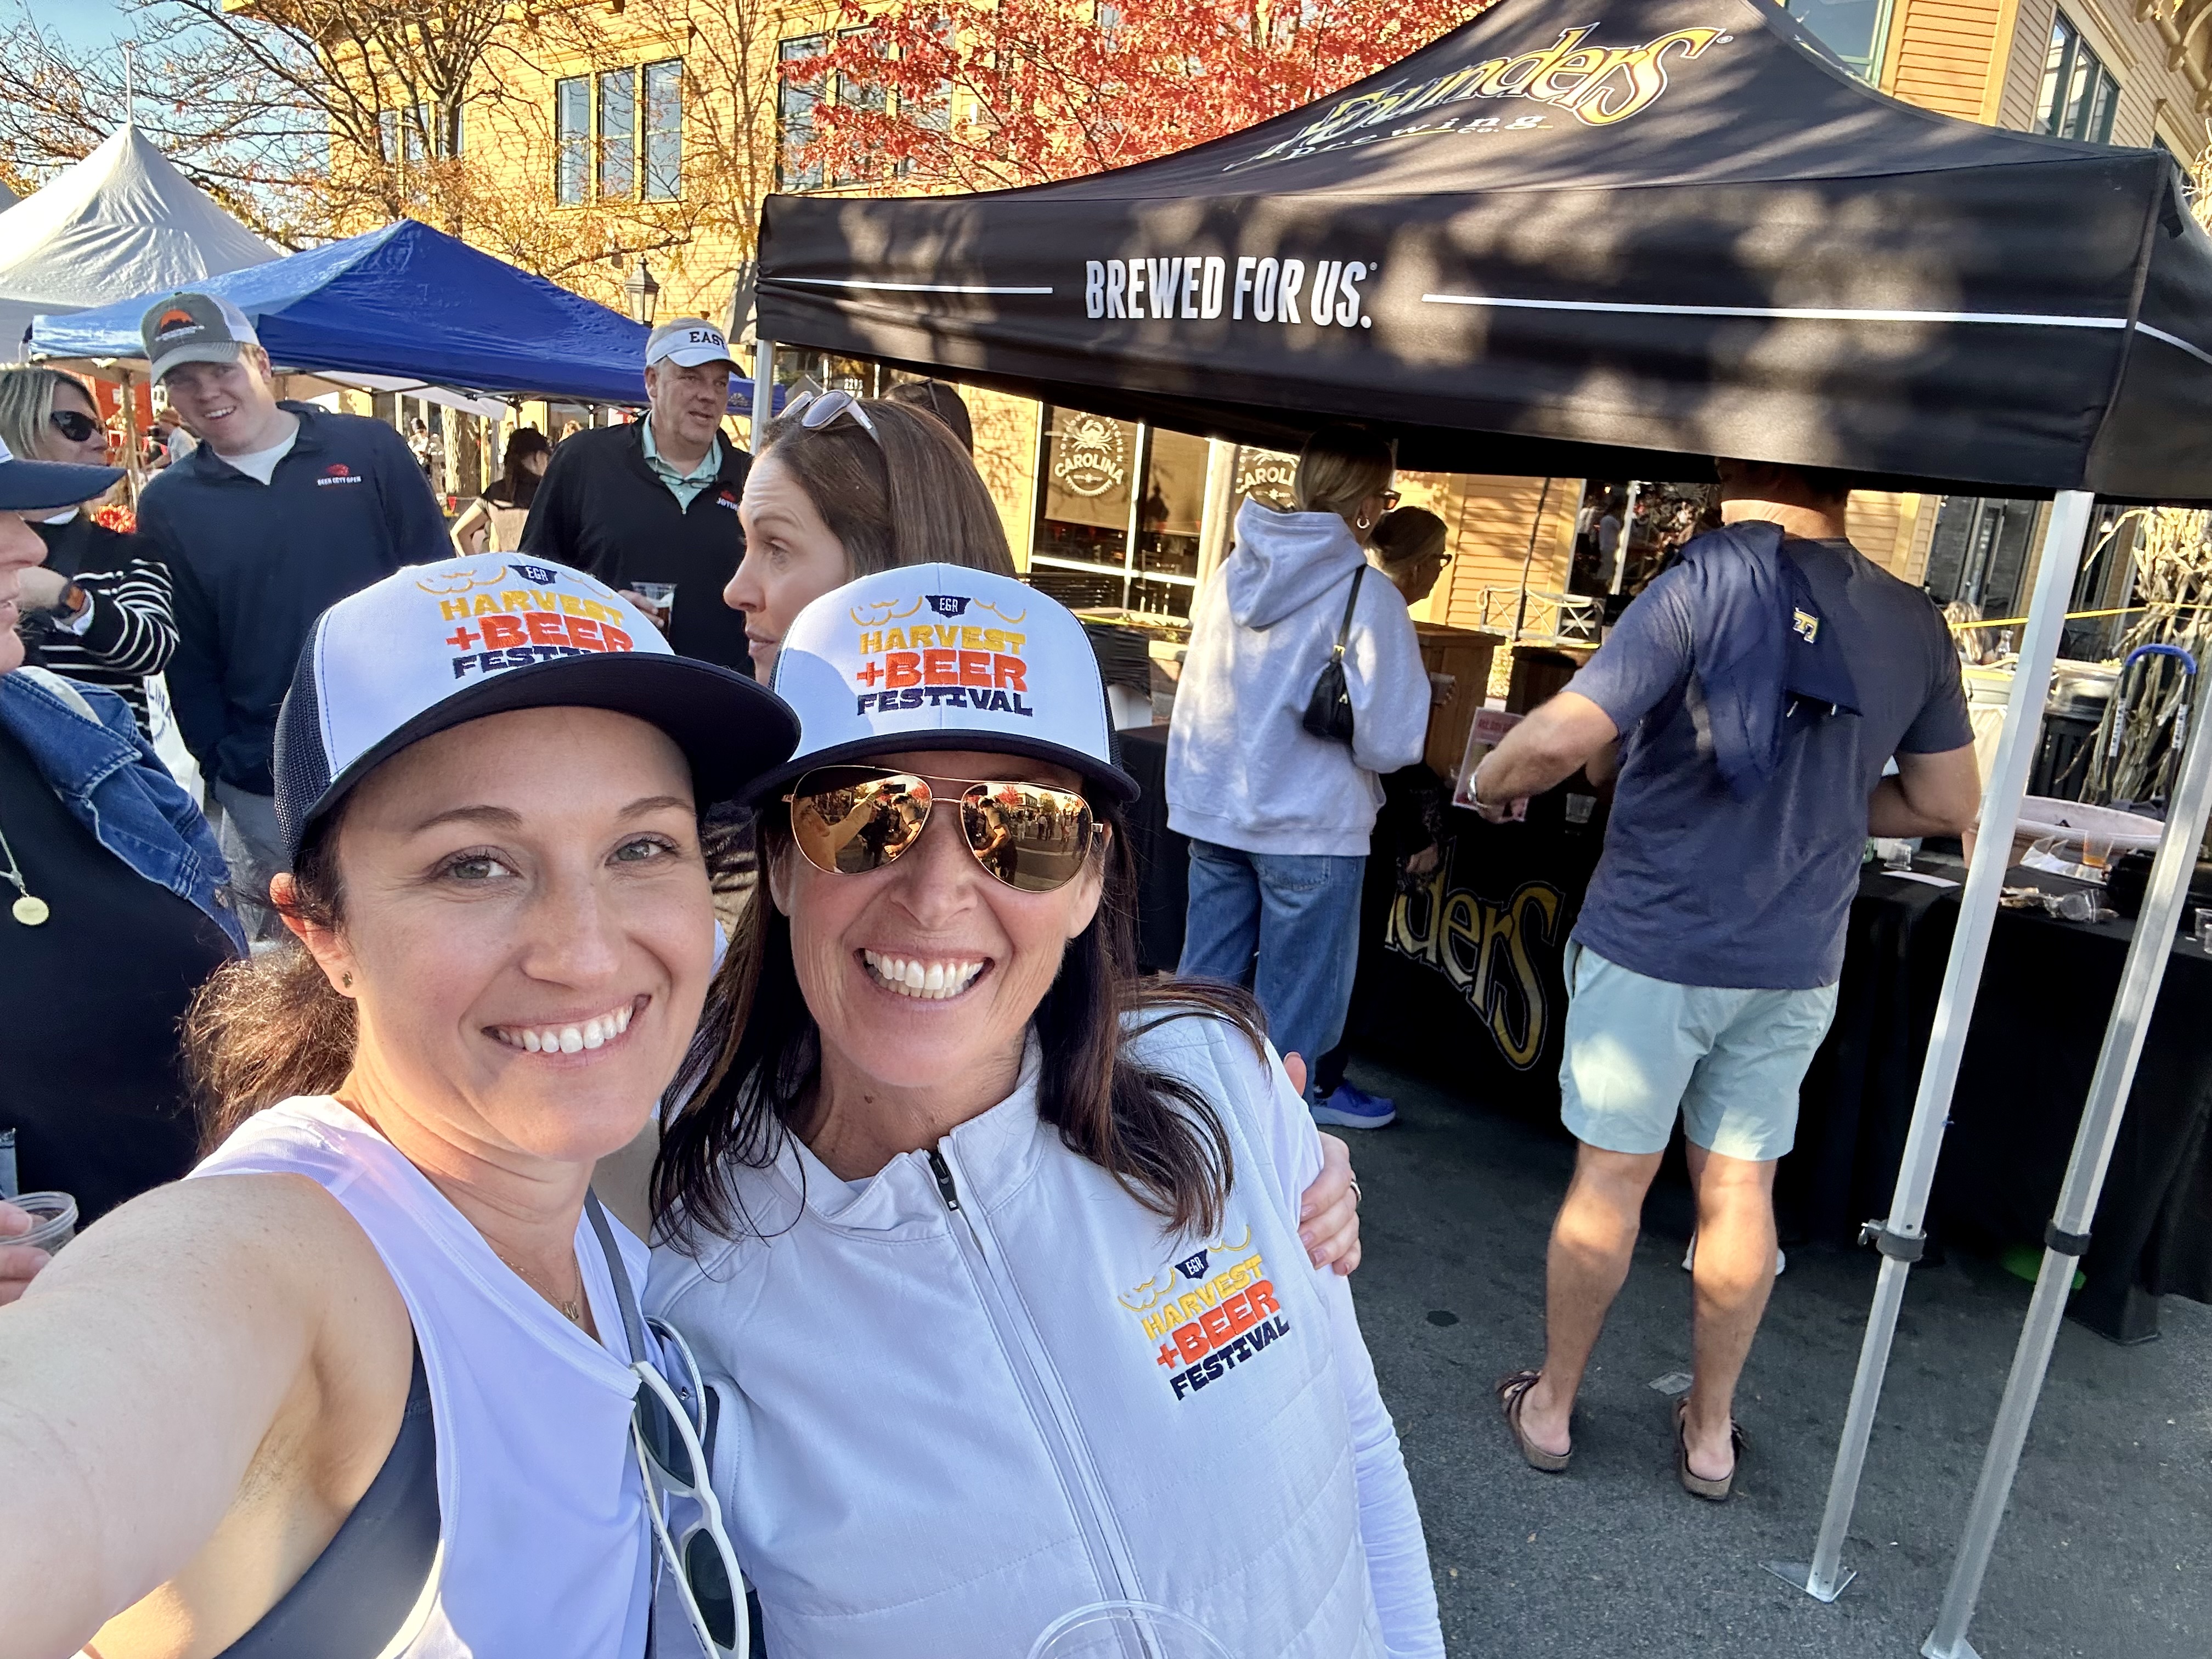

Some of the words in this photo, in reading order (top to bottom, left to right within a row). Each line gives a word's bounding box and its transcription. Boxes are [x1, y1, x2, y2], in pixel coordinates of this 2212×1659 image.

[1086, 256, 1226, 319] BREWED
[1233, 256, 1305, 324] FOR
[1054, 453, 1125, 485] CAROLINA
[525, 566, 549, 582] EGR
[439, 590, 625, 628] HARVEST
[939, 597, 959, 613] EGR
[859, 624, 1026, 655] HARVEST
[856, 648, 1028, 692] +BEER
[857, 686, 1034, 717] FESTIVAL
[1185, 1256, 1205, 1276] EGR
[1141, 1253, 1263, 1340] HARVEST
[1156, 1279, 1281, 1370] +BEER
[1169, 1315, 1291, 1401] FESTIVAL
